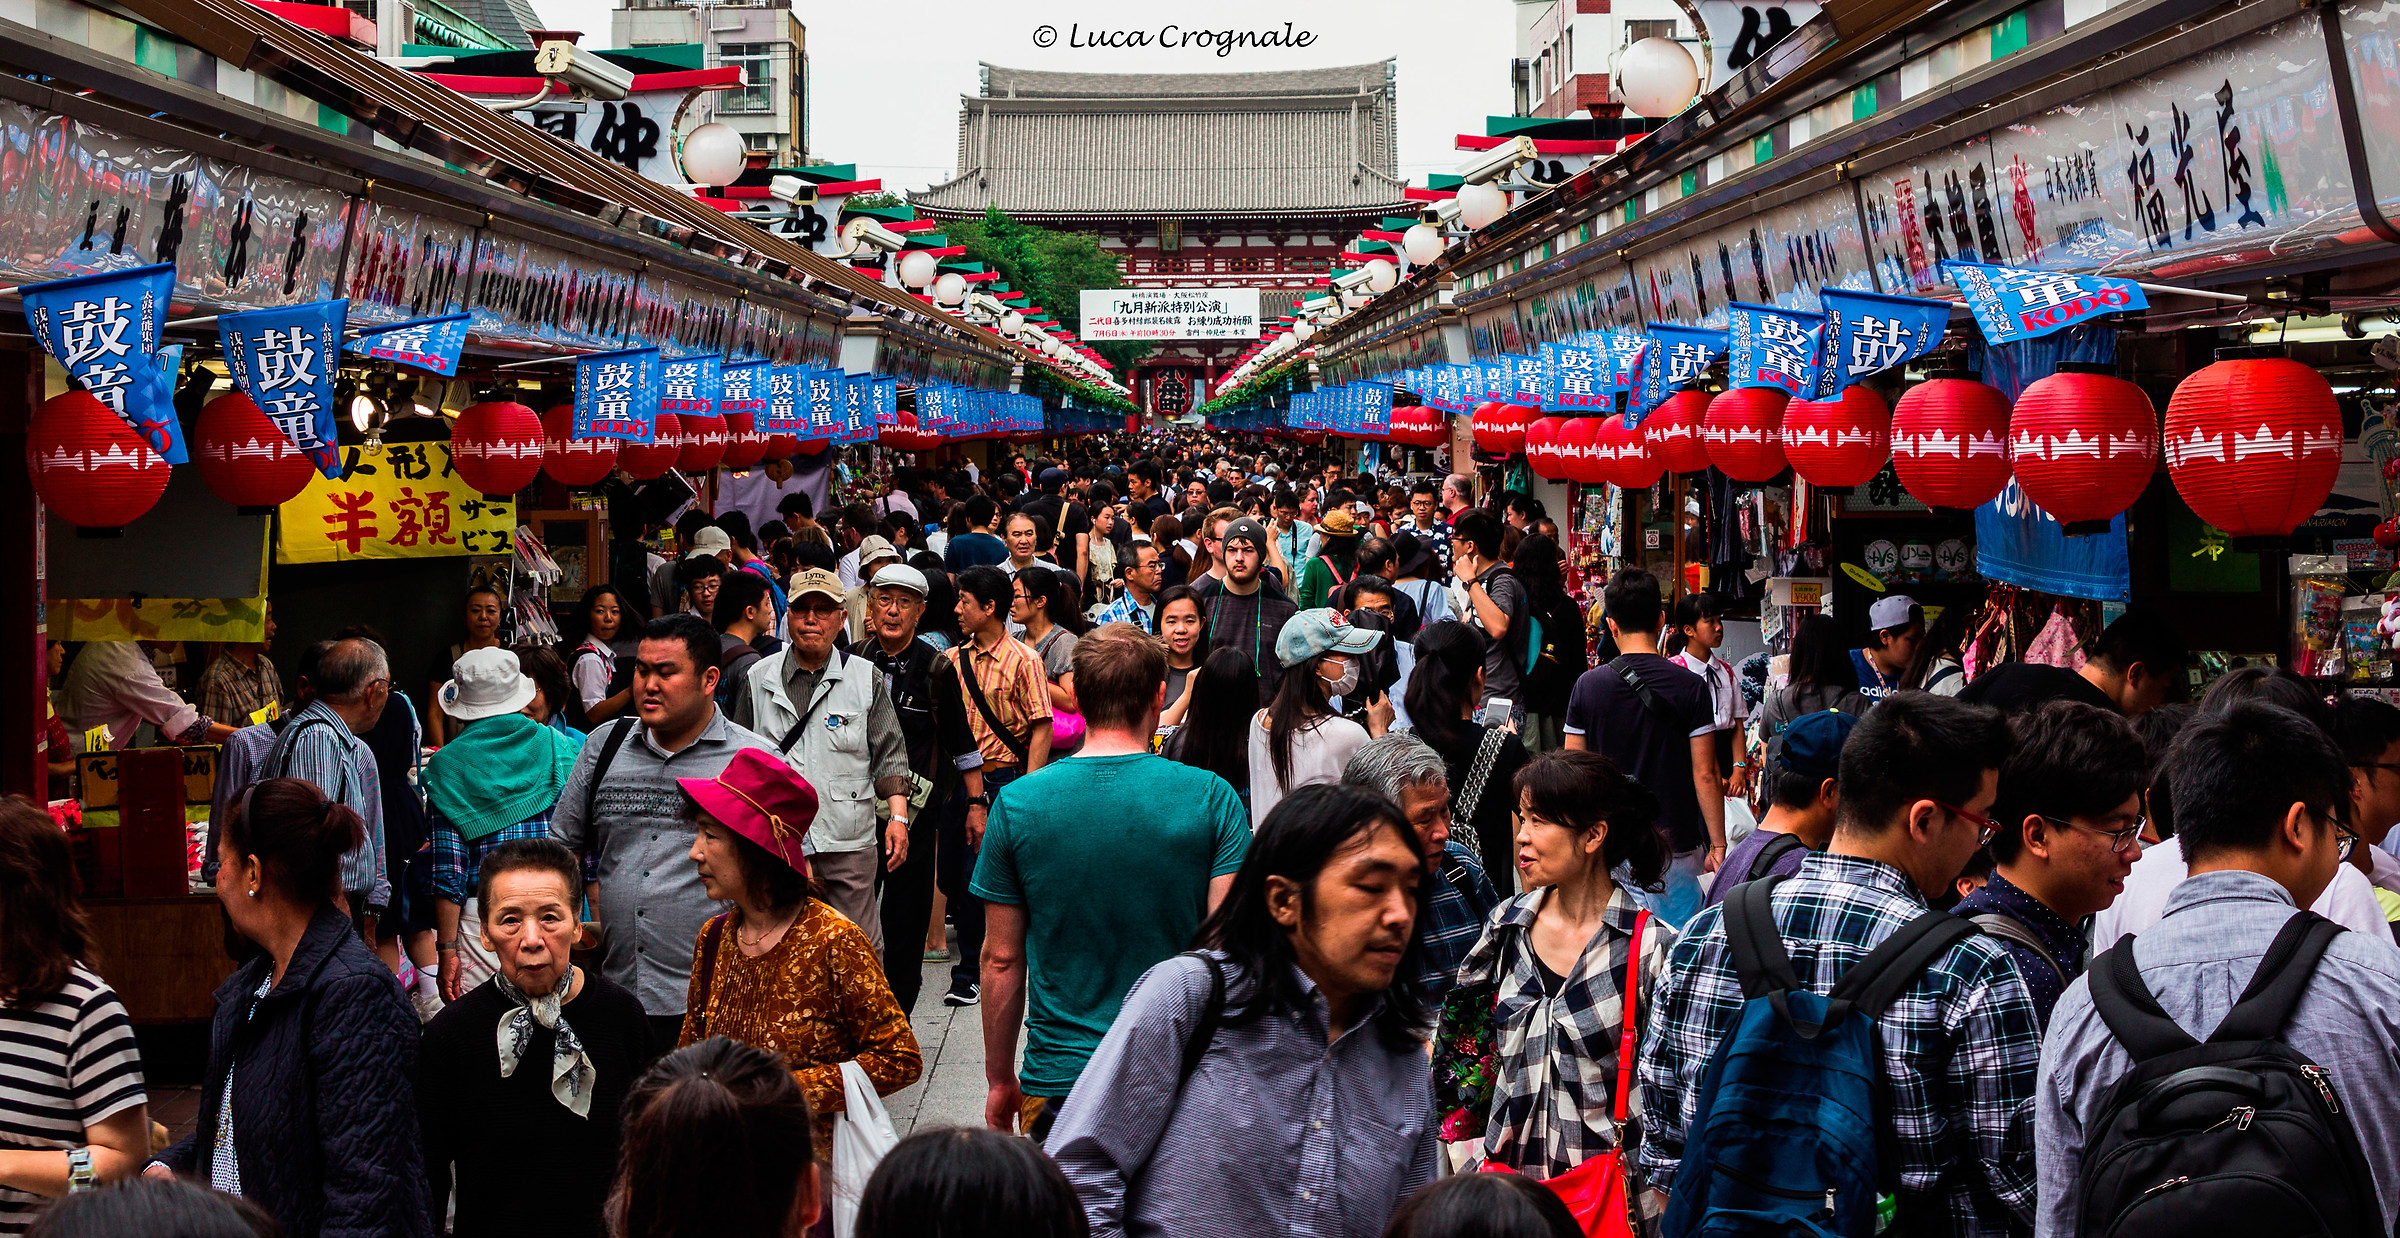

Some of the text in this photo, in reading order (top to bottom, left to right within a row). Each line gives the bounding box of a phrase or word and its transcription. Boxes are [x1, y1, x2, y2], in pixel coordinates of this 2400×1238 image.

[592, 361, 636, 422] 鼓童
[1558, 348, 1596, 397] 鼓童
[322, 486, 457, 555] 半額
[804, 572, 826, 580] Lynx
[1794, 592, 1818, 603] ¥900
